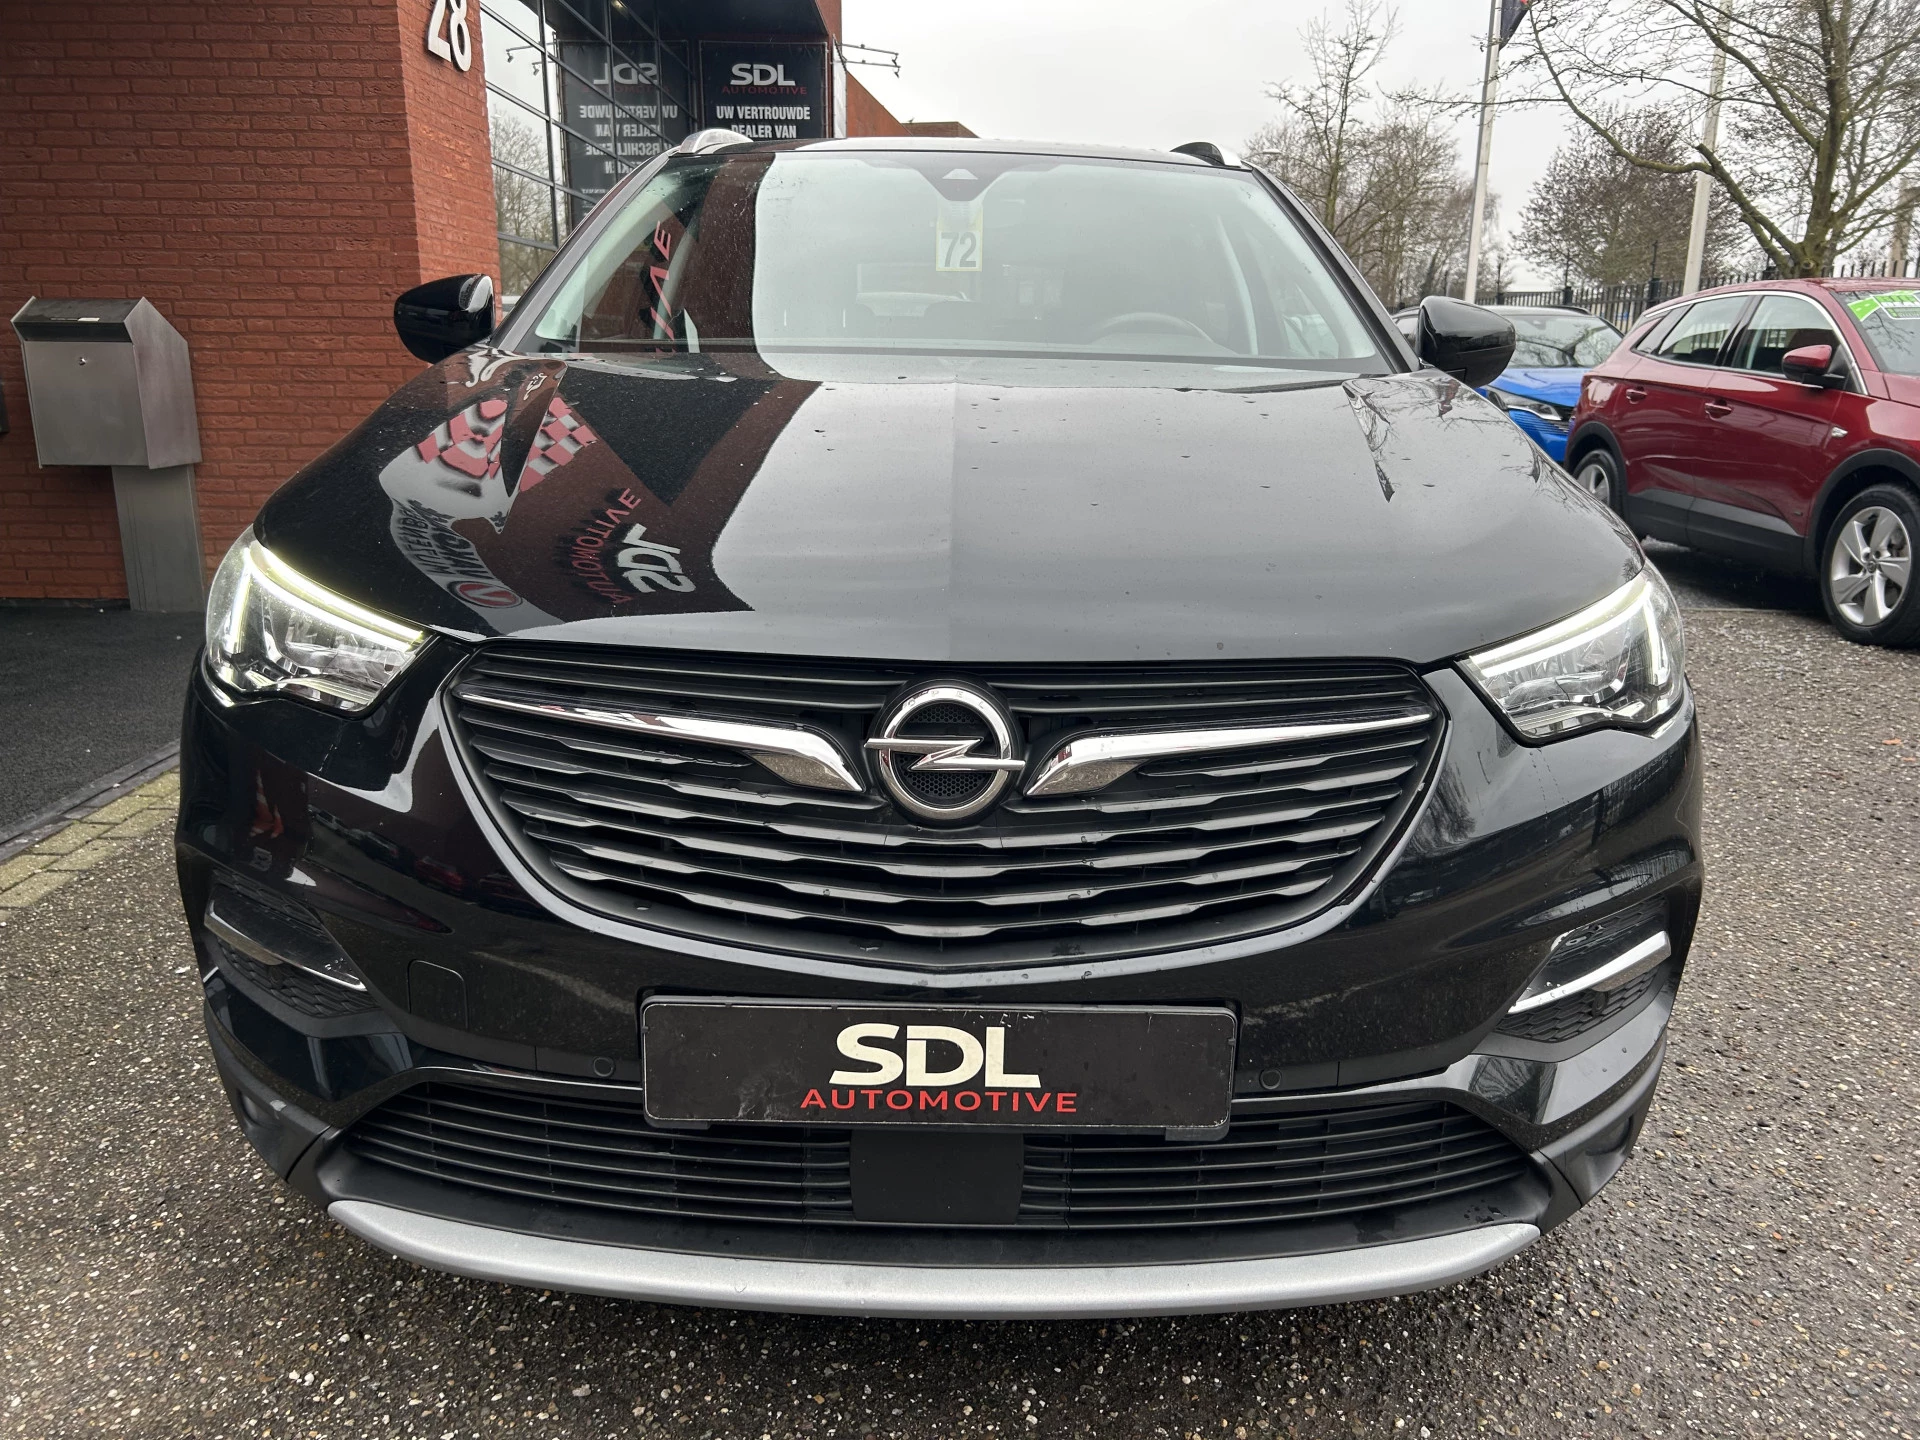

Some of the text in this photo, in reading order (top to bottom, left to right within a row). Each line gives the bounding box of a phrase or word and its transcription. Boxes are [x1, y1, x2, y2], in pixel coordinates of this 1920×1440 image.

[730, 63, 796, 86] SDL
[722, 85, 808, 95] AUTOMOTIVE
[716, 105, 811, 120] UW VERTROUWDE
[774, 125, 797, 138] VAN
[940, 231, 977, 268] 72
[829, 1023, 1042, 1088] SDL
[800, 1089, 1078, 1113] AUTOMOTIVE
